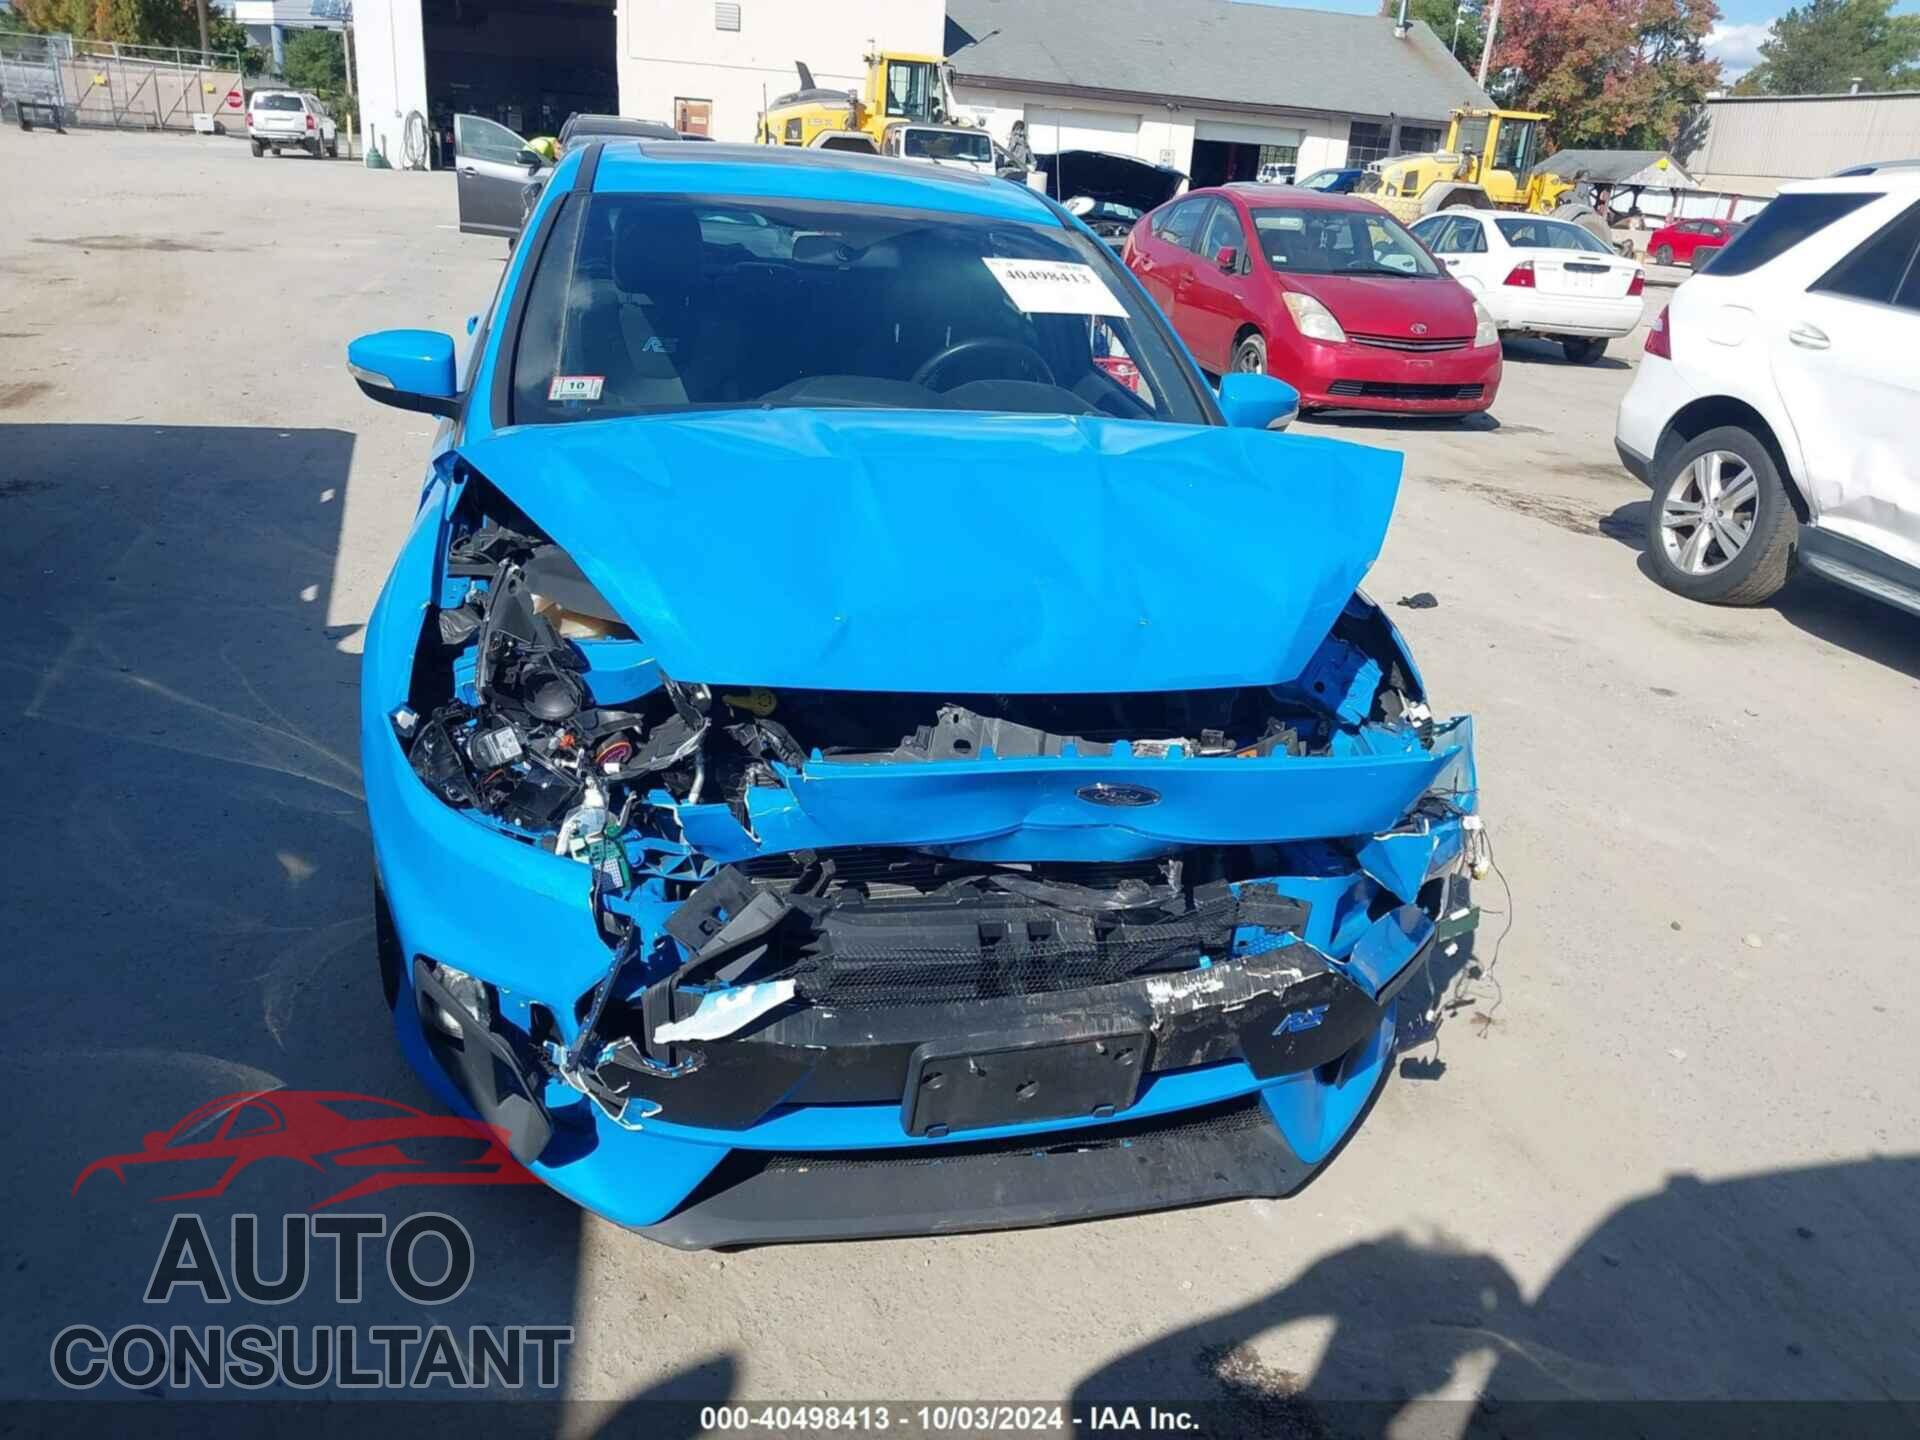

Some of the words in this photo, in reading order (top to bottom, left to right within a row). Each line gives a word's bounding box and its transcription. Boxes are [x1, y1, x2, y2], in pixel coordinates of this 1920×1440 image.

[1005, 269, 1091, 284] 40498413
[569, 382, 585, 390] 10
[1271, 1003, 1331, 1036] RS
